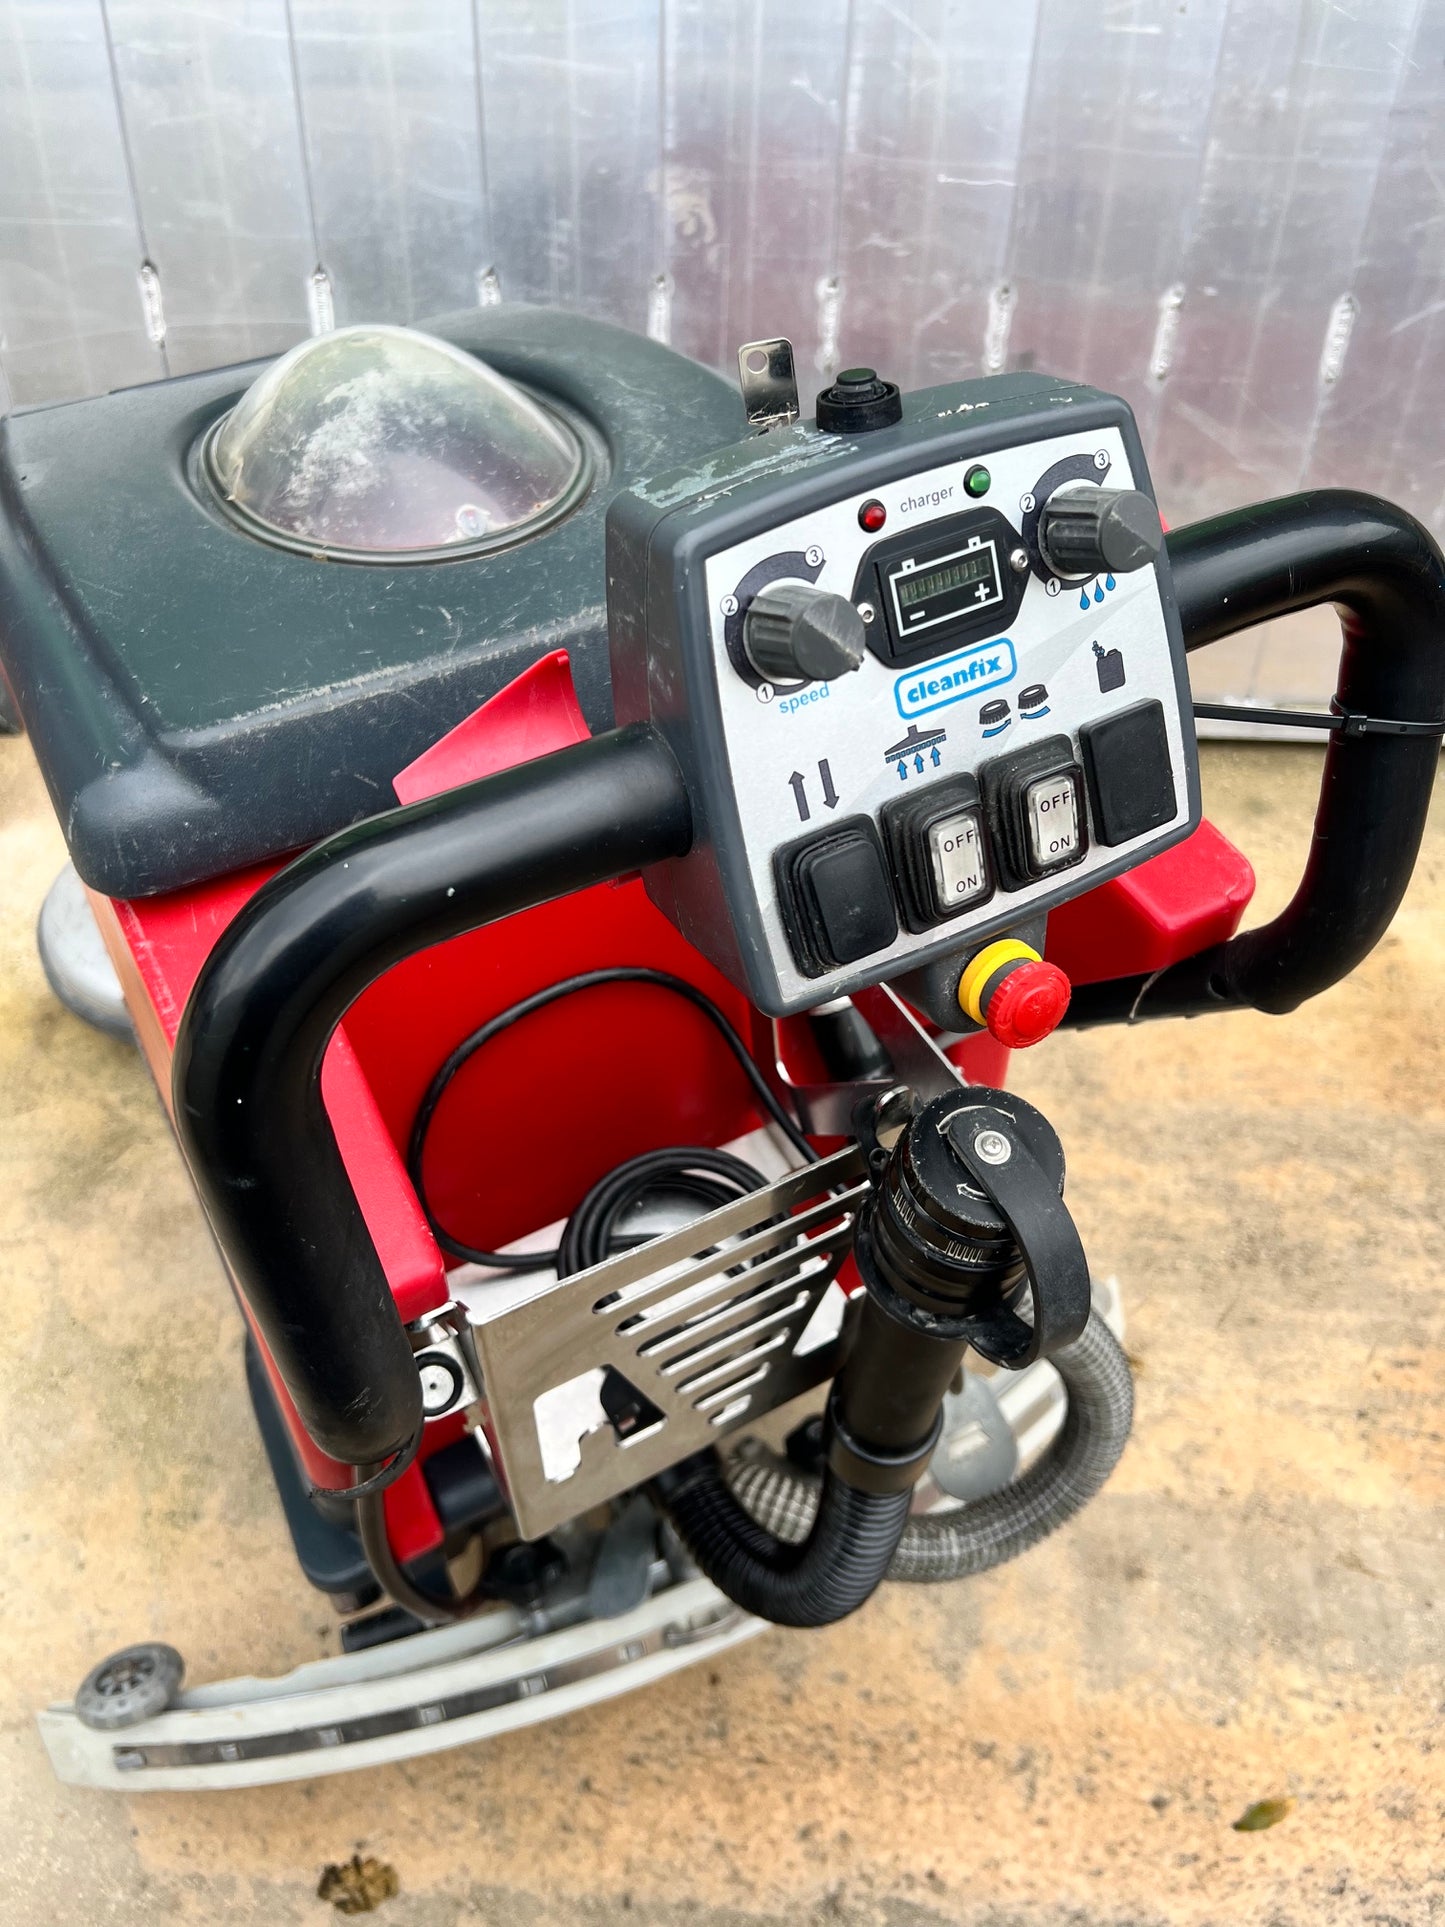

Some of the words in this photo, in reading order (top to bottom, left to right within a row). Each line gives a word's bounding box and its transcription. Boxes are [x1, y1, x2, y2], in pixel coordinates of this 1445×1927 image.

[1098, 453, 1105, 466] 3
[900, 486, 954, 512] charger
[1024, 497, 1033, 511] 2
[810, 549, 819, 563] 3
[725, 598, 735, 614] 2
[907, 656, 1002, 703] cleanfix
[779, 681, 830, 713] speed
[1040, 791, 1070, 813] OFF
[943, 829, 974, 853] OFF
[1050, 835, 1070, 853] ON
[956, 874, 977, 893] ON
